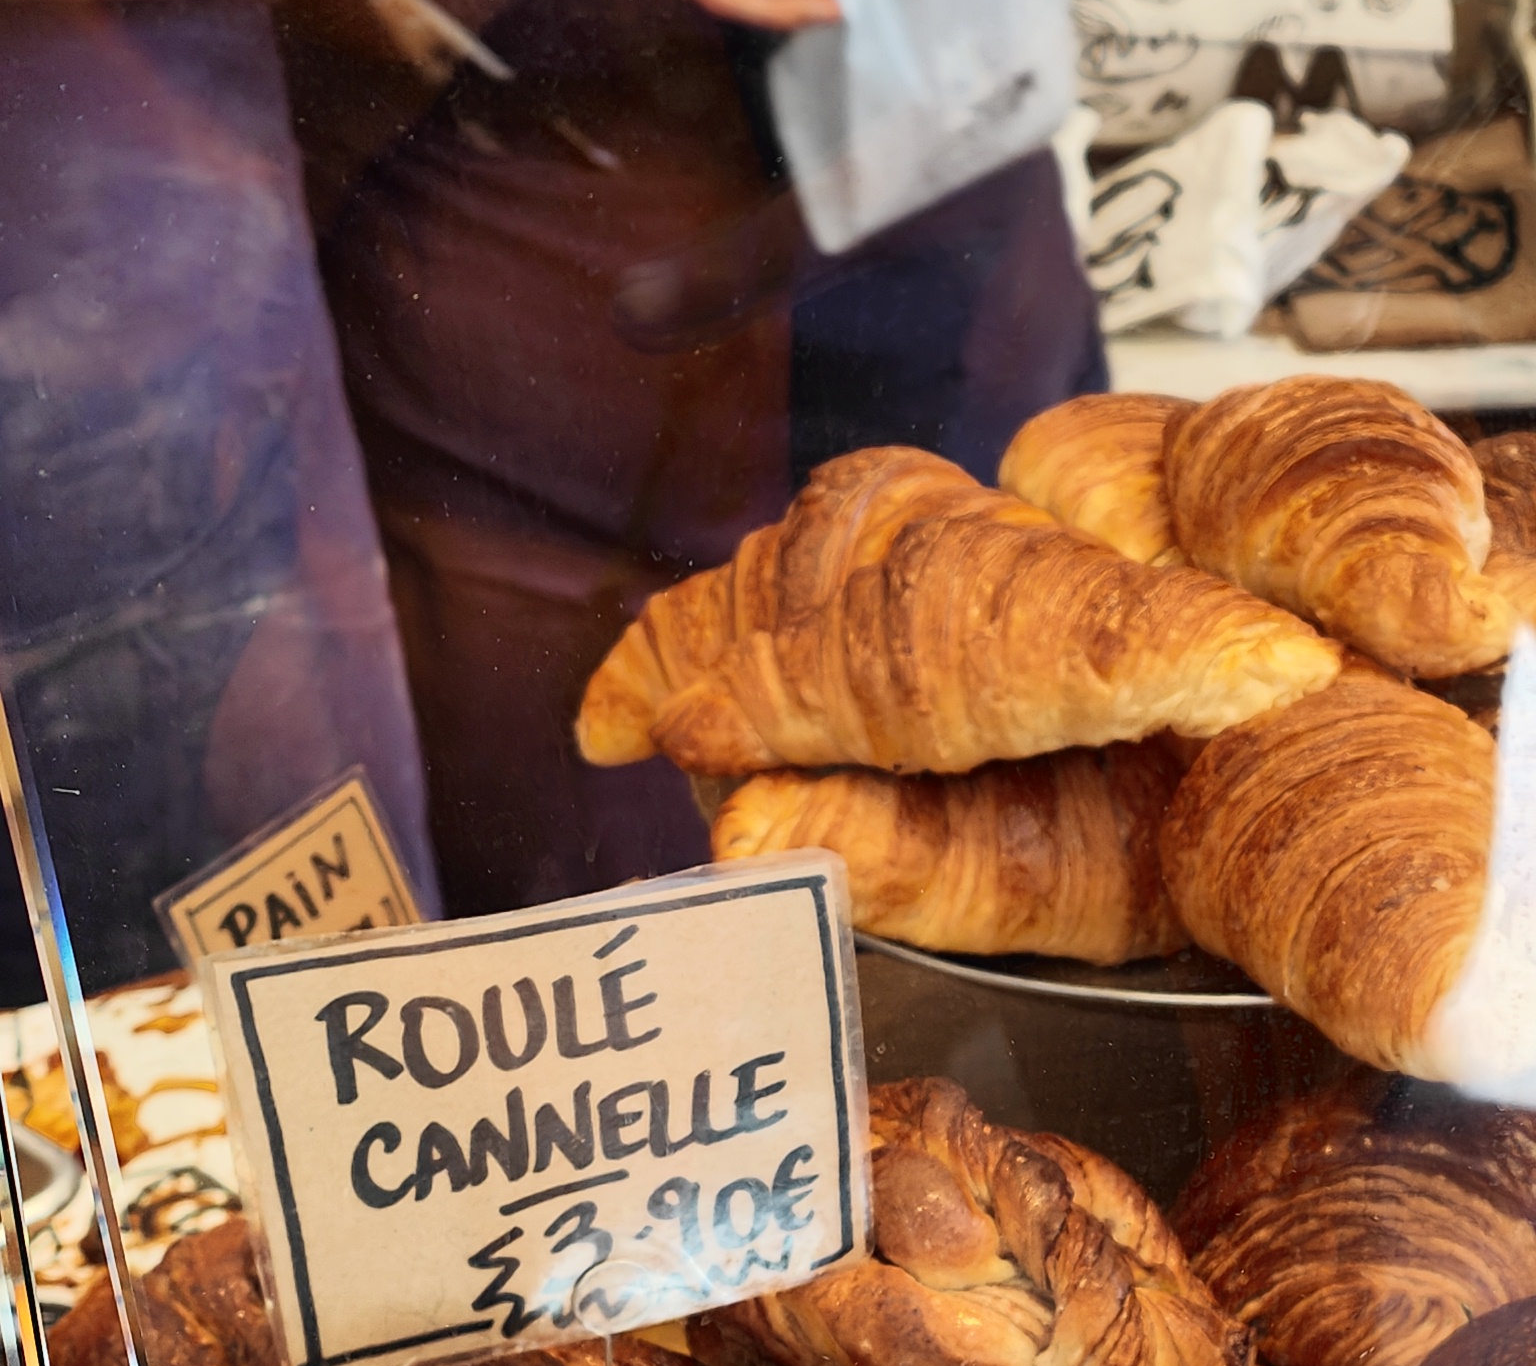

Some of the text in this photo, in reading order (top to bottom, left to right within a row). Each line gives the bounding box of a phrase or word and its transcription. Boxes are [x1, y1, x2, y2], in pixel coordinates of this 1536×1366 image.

[314, 924, 663, 1105] ROULÉ
[350, 1051, 787, 1210] CANNELLE
[545, 1144, 820, 1280] 3.90€
